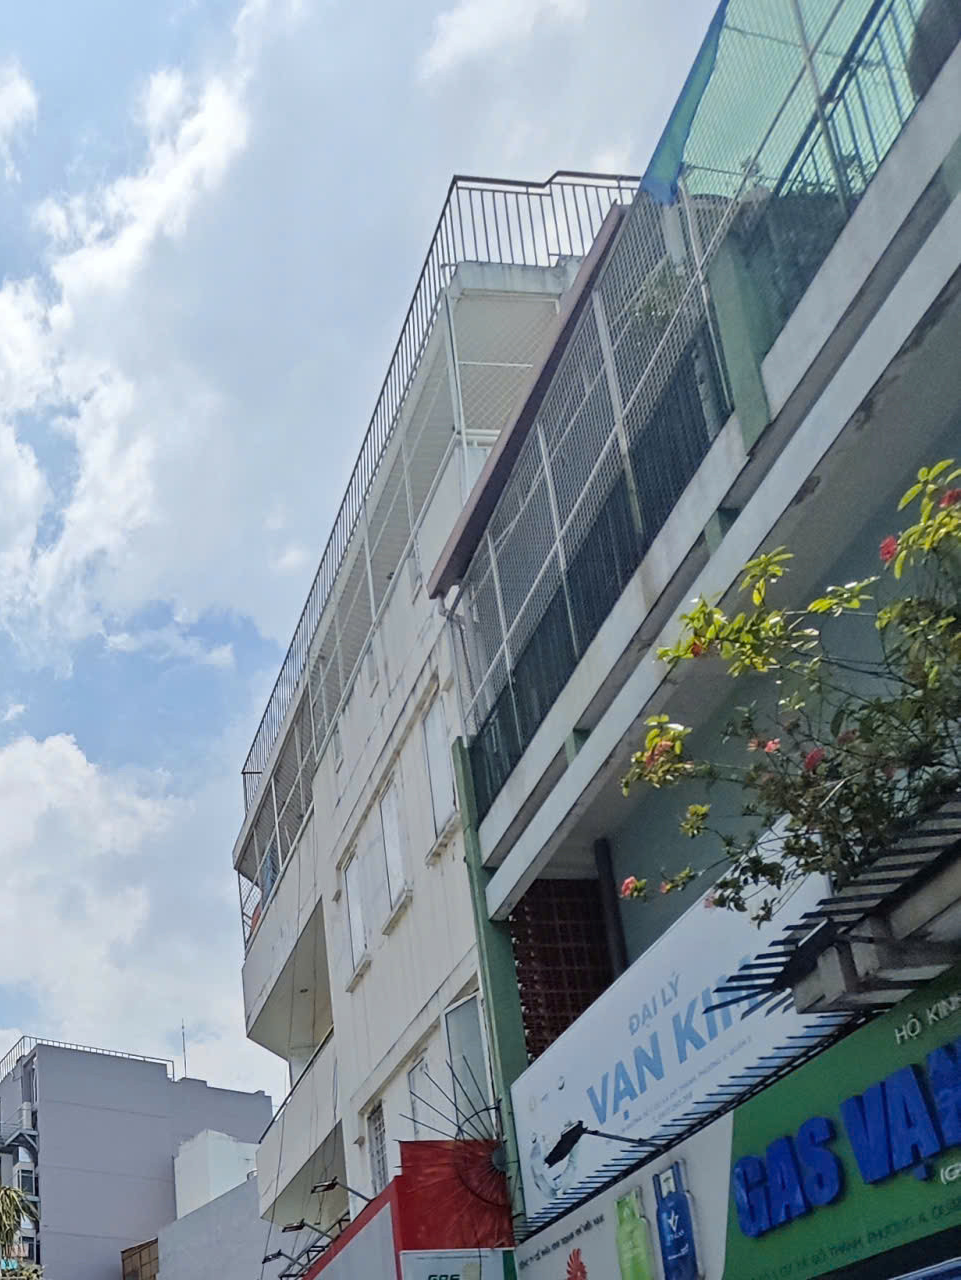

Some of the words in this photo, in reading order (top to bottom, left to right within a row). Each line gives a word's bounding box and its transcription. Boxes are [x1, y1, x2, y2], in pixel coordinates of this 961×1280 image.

[628, 995, 658, 1036] ĐẠI
[661, 971, 680, 1008] LÝ
[587, 1031, 665, 1126] VẠN
[733, 1116, 843, 1238] GAS
